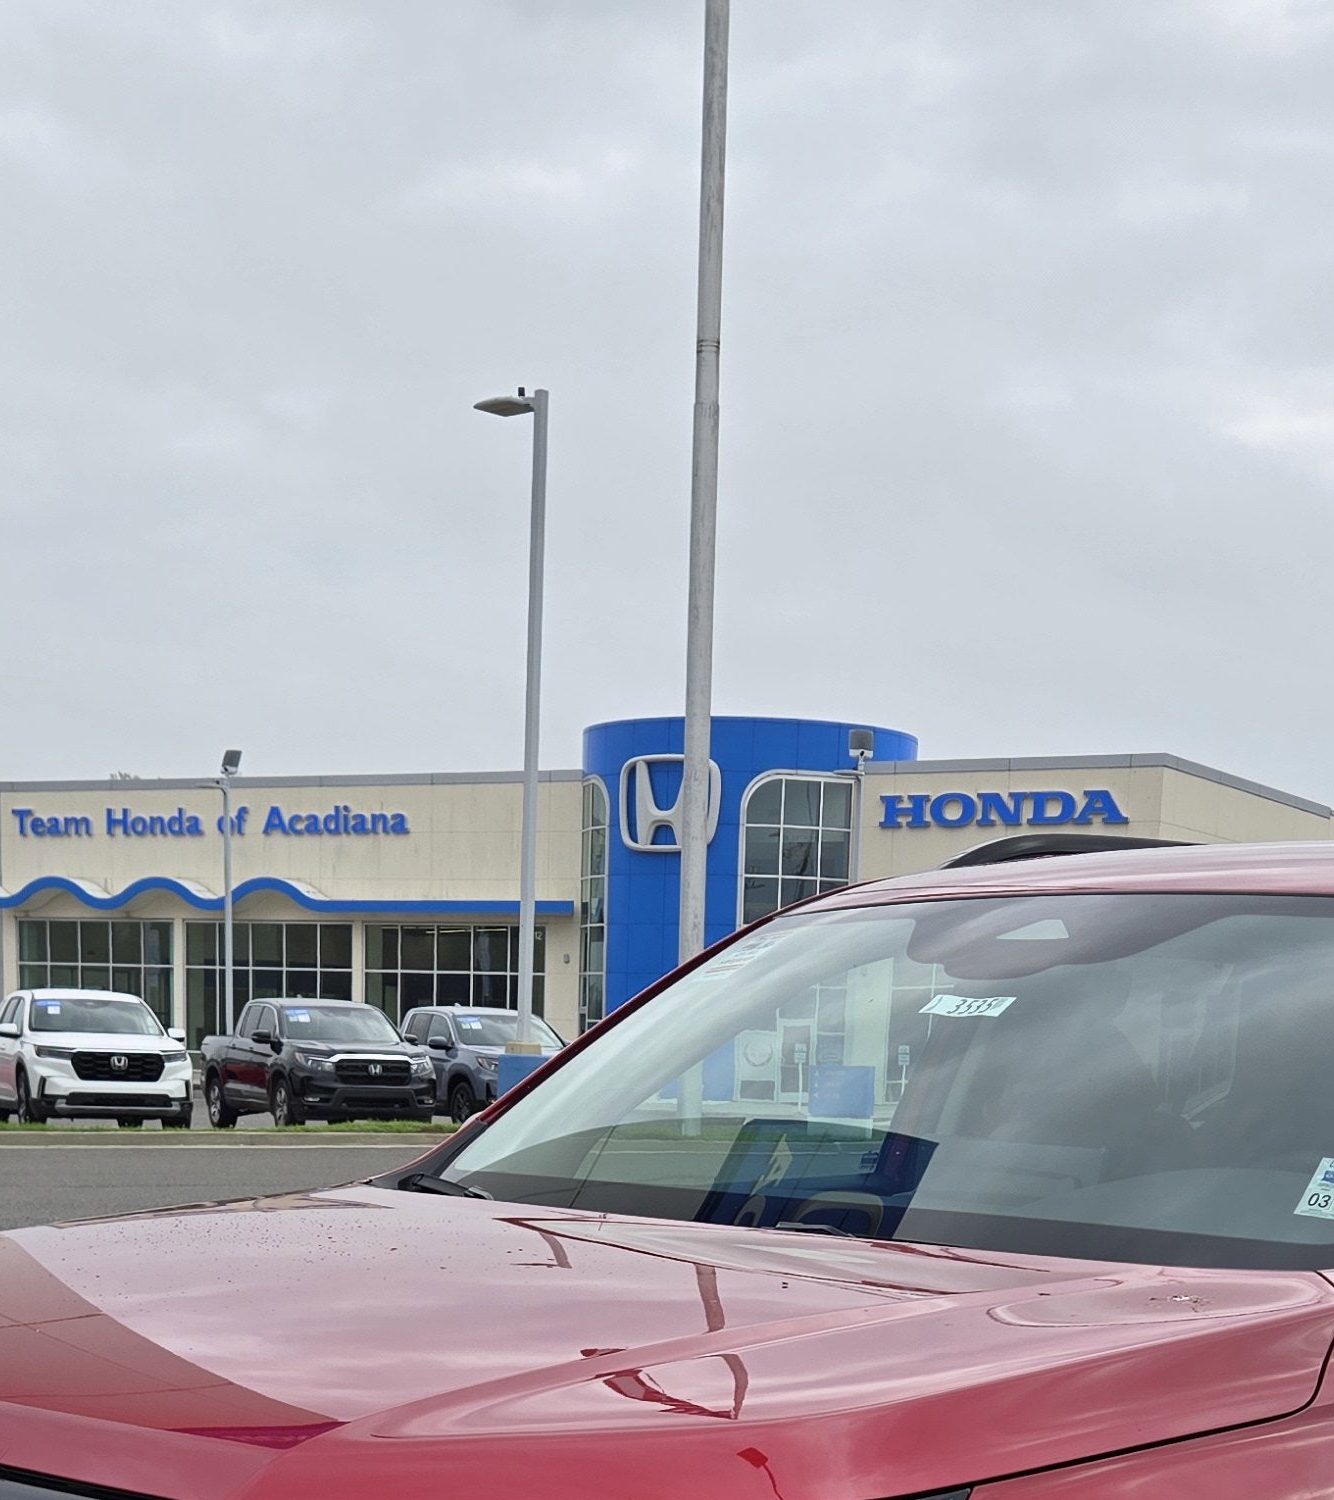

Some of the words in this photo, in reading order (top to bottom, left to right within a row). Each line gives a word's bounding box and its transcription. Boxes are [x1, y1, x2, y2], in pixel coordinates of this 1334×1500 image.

[11, 808, 92, 837] Team
[105, 807, 205, 837] Honda
[216, 806, 249, 836] of
[262, 805, 411, 836] Acadiana
[879, 790, 1129, 828] HONDA
[1307, 1192, 1332, 1209] 03
